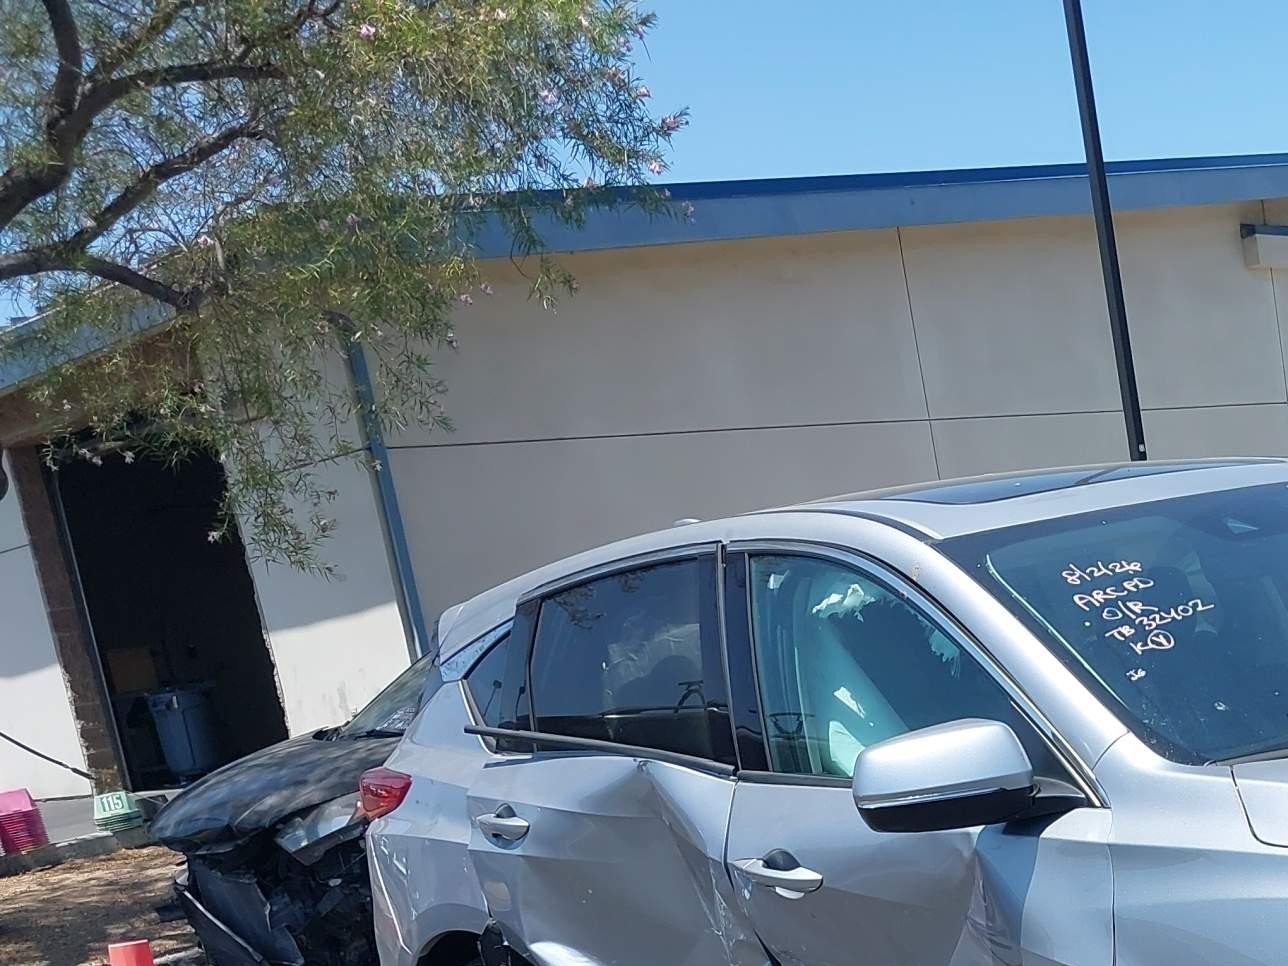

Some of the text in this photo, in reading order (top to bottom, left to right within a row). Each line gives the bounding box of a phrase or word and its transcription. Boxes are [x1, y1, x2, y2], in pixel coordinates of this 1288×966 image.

[1062, 561, 1142, 585] 8/2/26
[1135, 599, 1215, 631] 32402
[101, 794, 124, 812] 115
